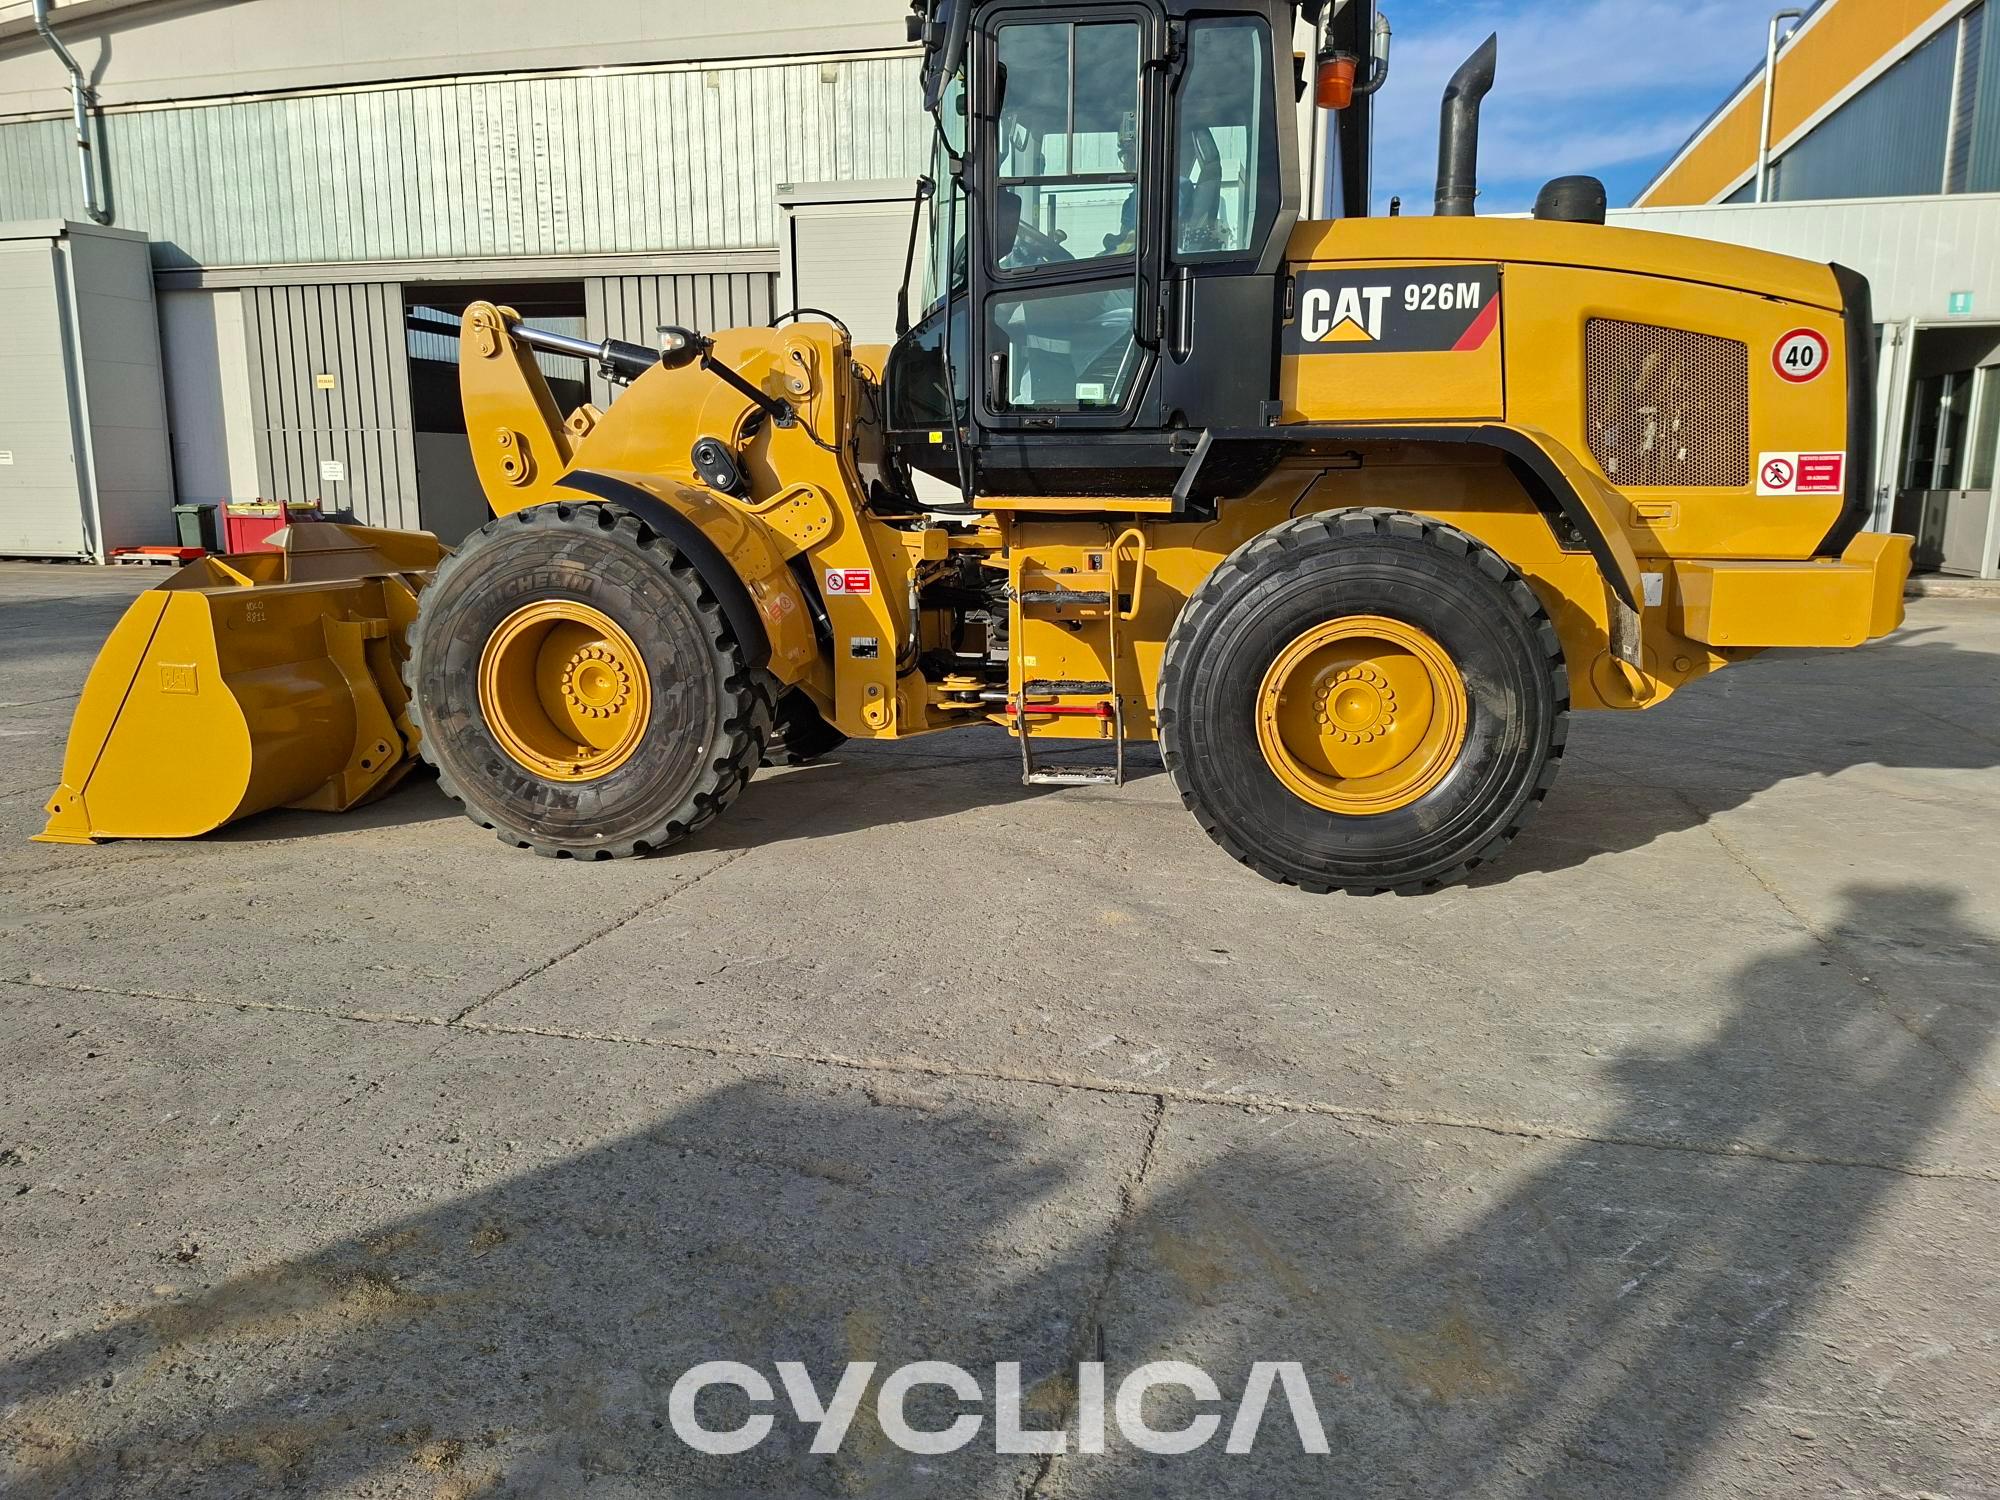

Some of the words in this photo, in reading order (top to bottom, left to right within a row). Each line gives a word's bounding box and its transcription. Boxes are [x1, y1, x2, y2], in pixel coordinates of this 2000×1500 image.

[1300, 286, 1392, 342] CAT
[1404, 282, 1480, 311] 926M
[1785, 345, 1814, 367] 40
[482, 573, 593, 614] MICHELIN
